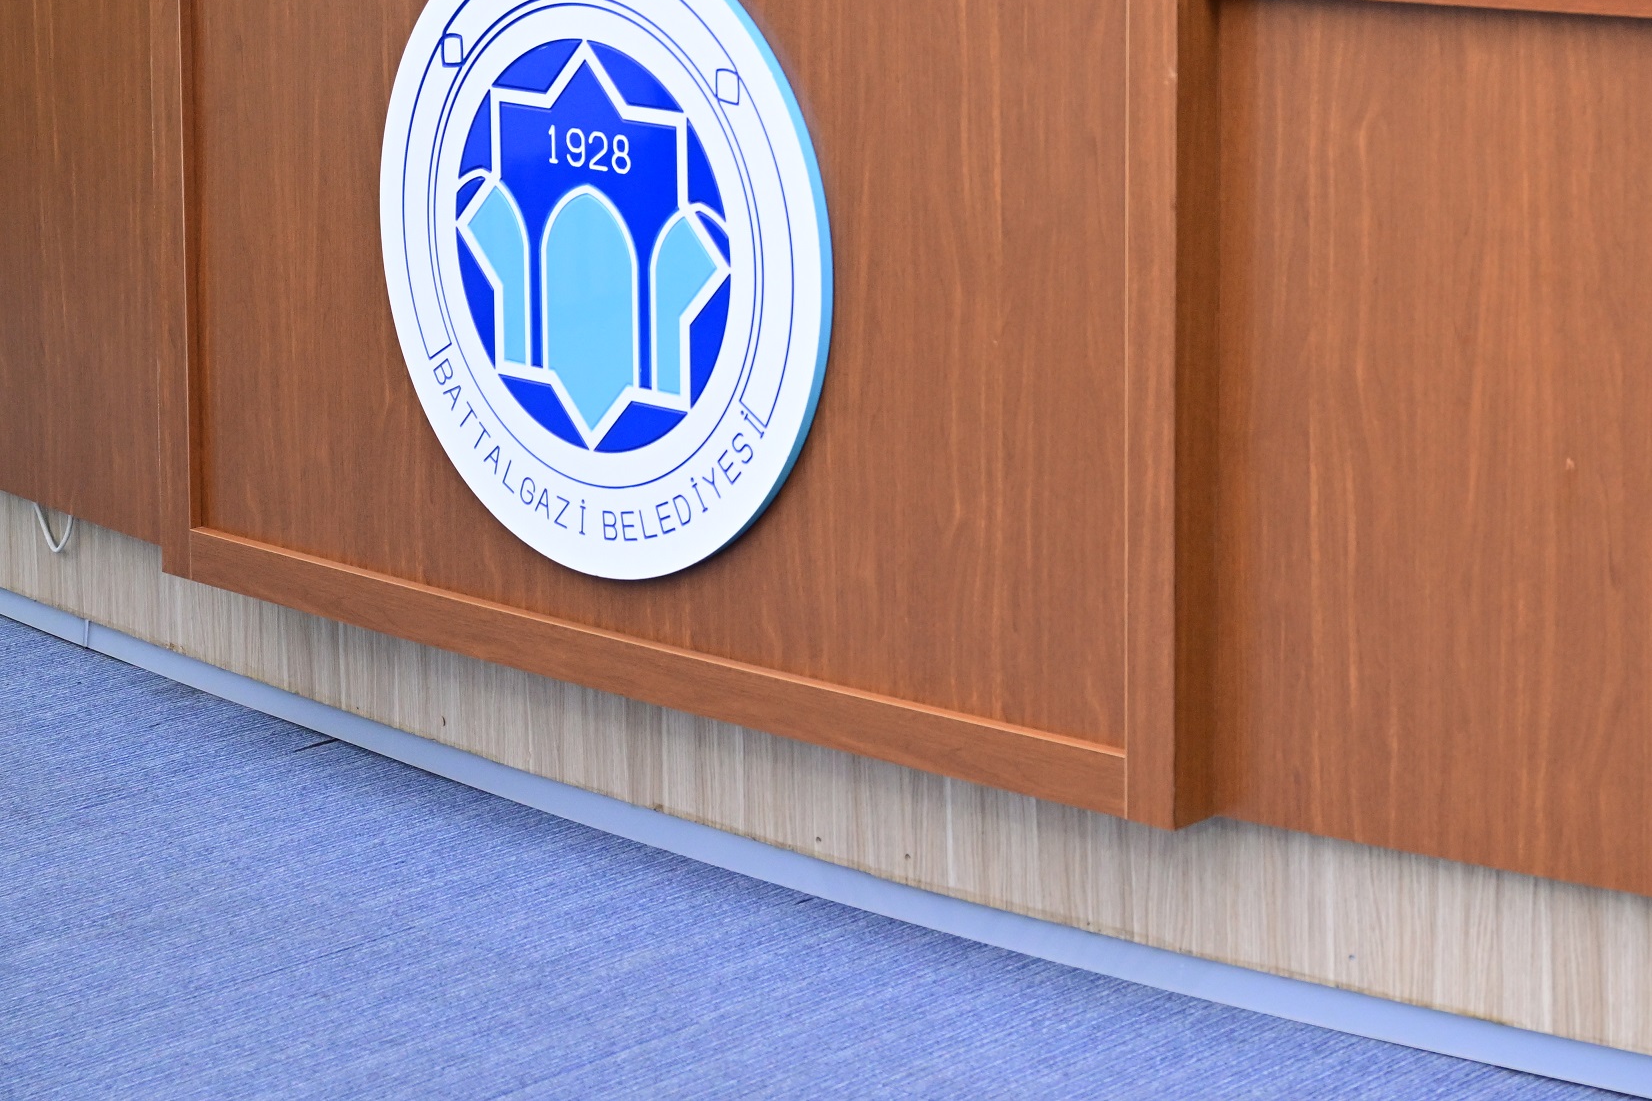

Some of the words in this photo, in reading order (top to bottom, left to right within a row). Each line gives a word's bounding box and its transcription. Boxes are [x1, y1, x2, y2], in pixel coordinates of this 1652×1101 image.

[547, 124, 632, 175] 1928
[432, 358, 586, 536] BATTALGAZİ
[602, 410, 766, 542] BELEDİYESİ
